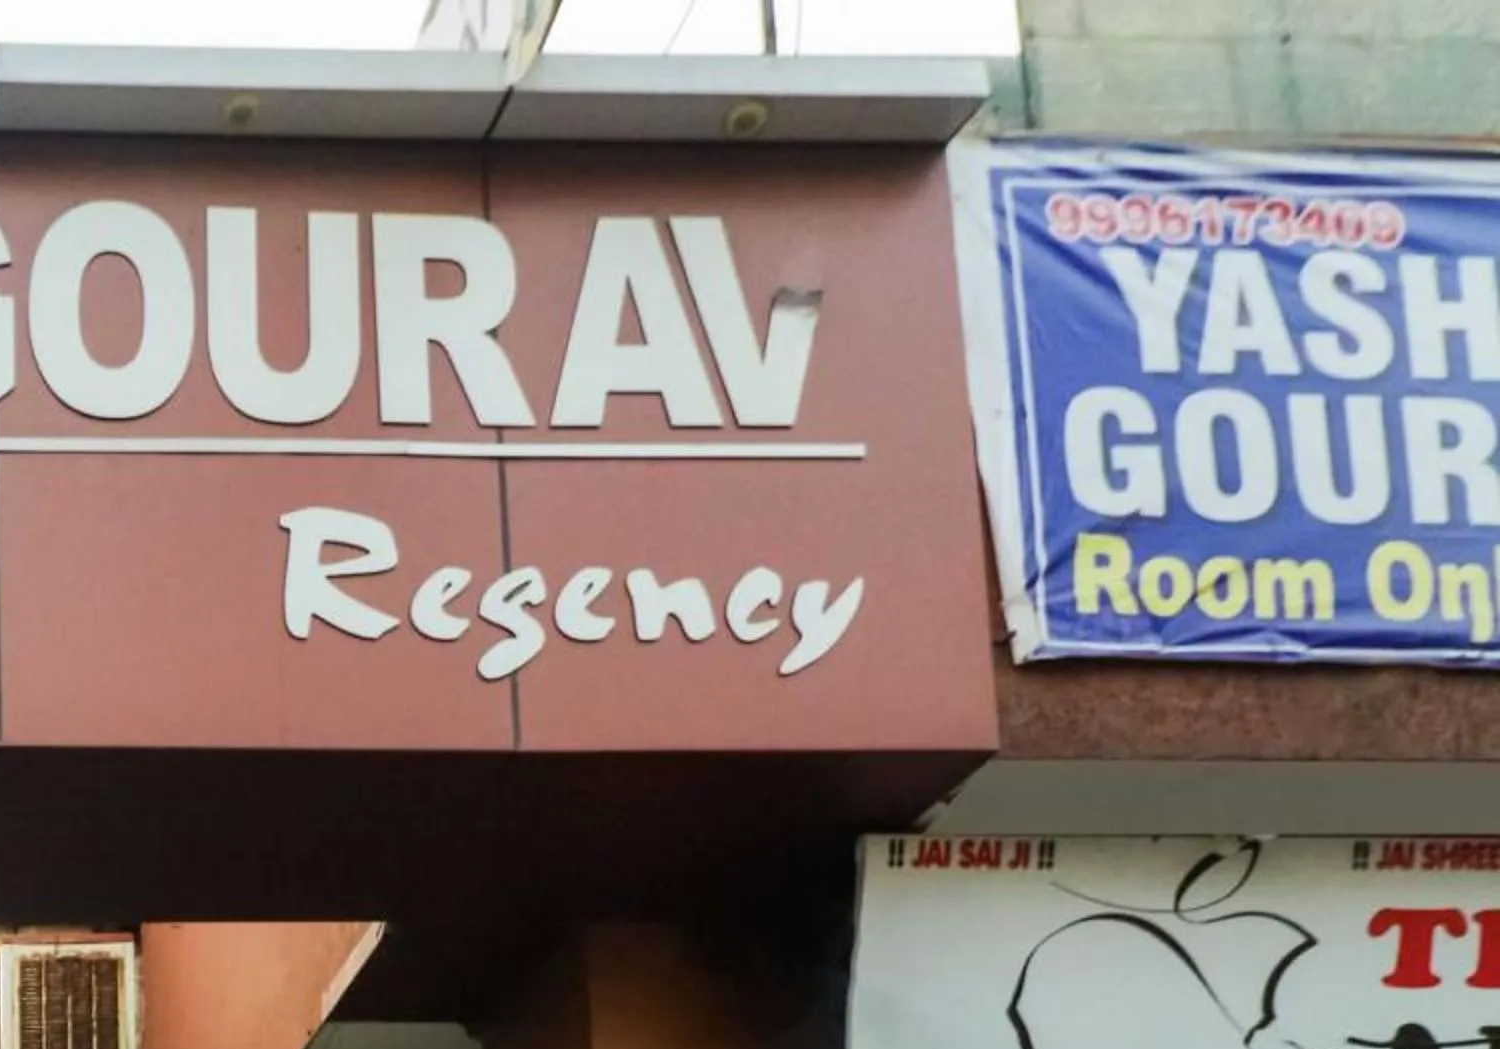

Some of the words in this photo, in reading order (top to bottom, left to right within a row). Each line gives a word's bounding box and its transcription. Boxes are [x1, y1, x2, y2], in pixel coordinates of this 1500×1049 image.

[1103, 248, 1500, 382] YASH
[1064, 386, 1500, 526] GOUR
[280, 506, 865, 680] Regency
[1073, 532, 1335, 620] Room
[912, 840, 951, 868] JAI
[958, 840, 1002, 869] SAI
[1376, 841, 1415, 870] JAI
